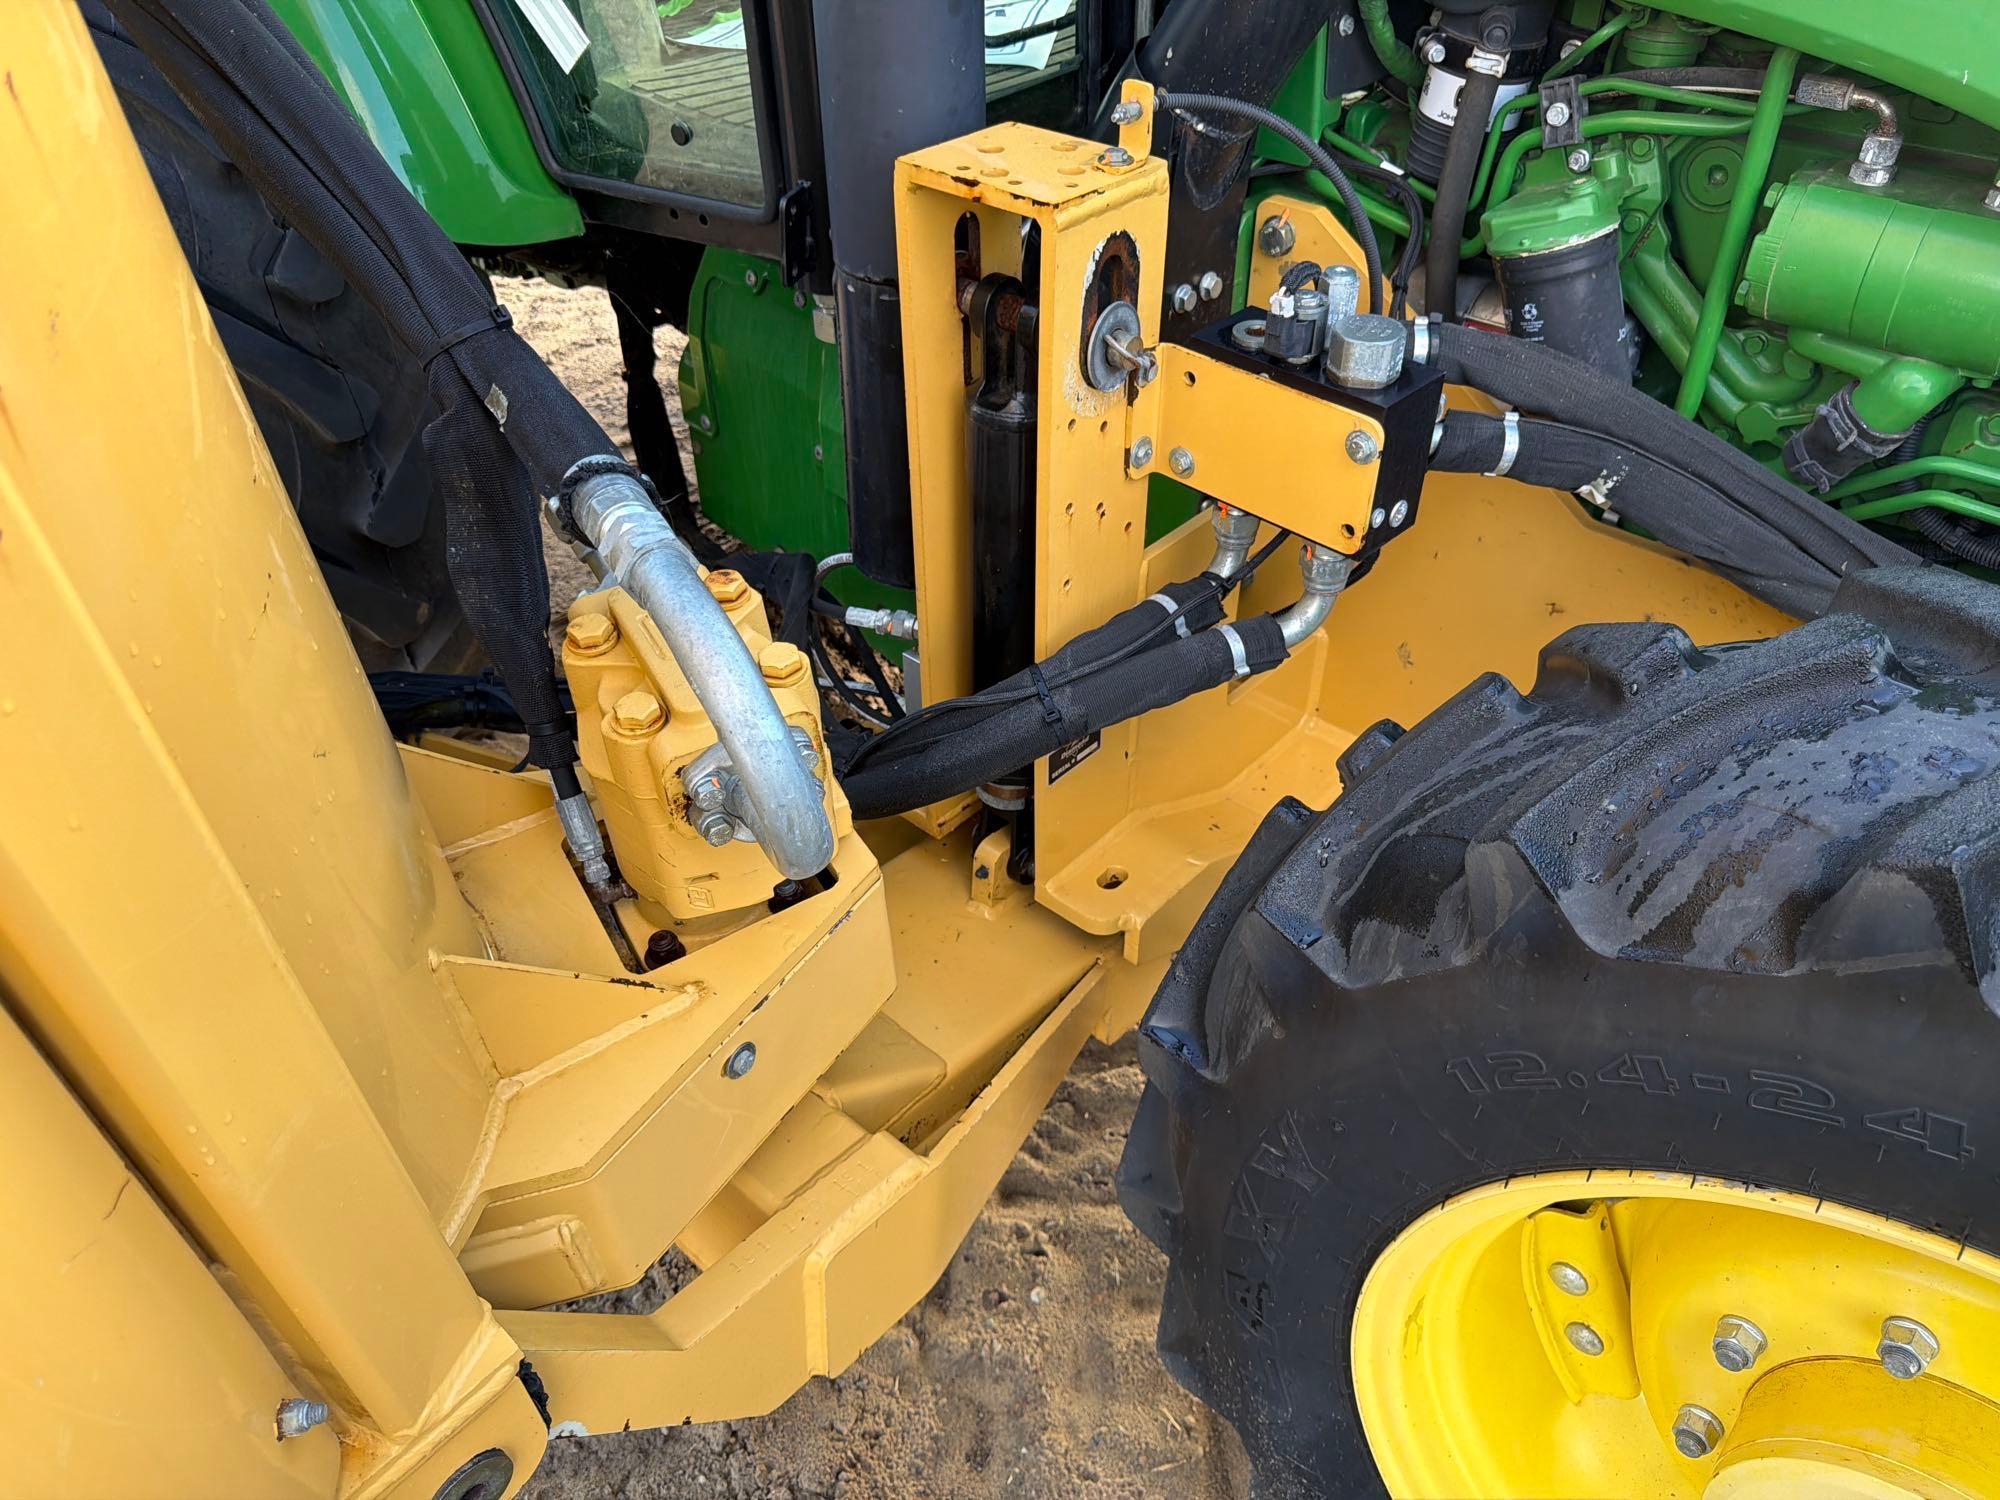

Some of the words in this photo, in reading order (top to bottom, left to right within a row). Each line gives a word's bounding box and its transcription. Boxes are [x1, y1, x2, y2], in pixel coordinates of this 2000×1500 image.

[1437, 110, 1457, 122] JOH
[1051, 761, 1072, 779] SERIAL
[1444, 1049, 1976, 1163] 12.4-24
